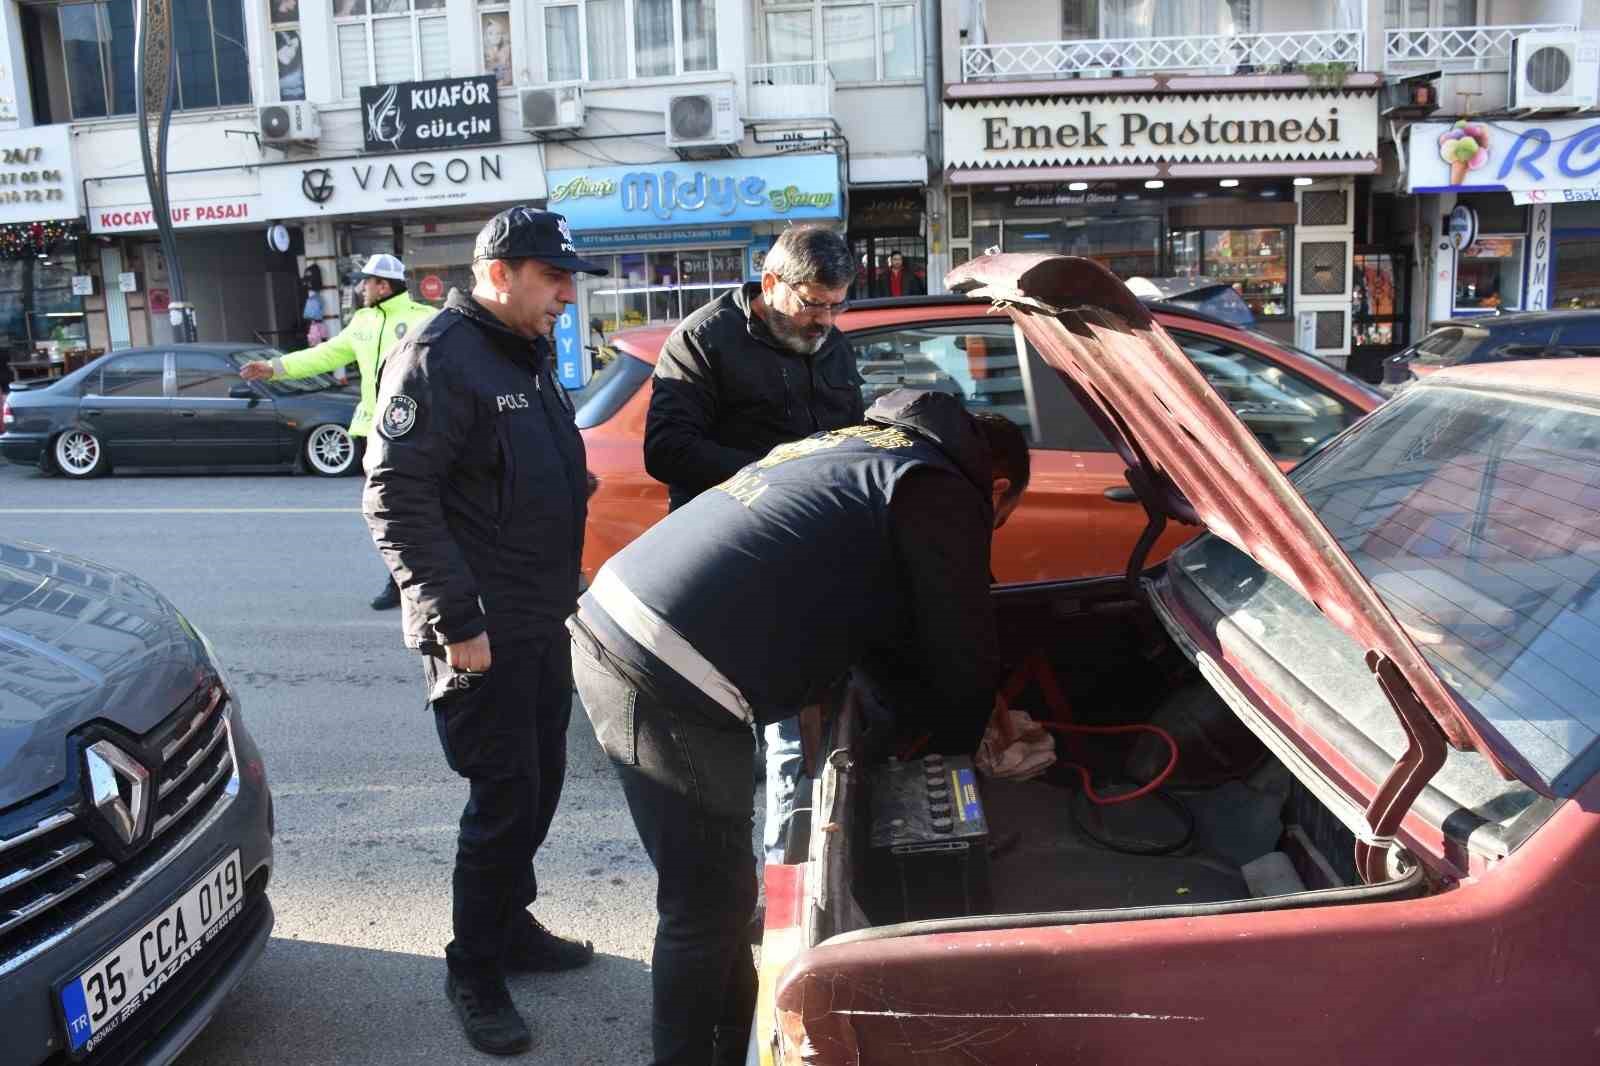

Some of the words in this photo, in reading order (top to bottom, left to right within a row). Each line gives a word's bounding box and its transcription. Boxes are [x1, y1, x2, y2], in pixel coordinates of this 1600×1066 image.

[411, 81, 491, 110] KUAFÖR
[415, 117, 491, 140] GÜLÇİN
[981, 110, 1108, 152] Emek
[1120, 107, 1341, 147] Pastanesi
[352, 154, 503, 190] VAGON
[620, 170, 768, 220] Midye
[101, 208, 191, 228] KOCAYUF
[196, 203, 248, 220] PASAJI
[87, 956, 126, 1021] 35
[139, 907, 188, 978] CCA
[199, 863, 237, 925] 019
[142, 940, 203, 1002] NAZAR
[71, 1013, 88, 1033] TR
